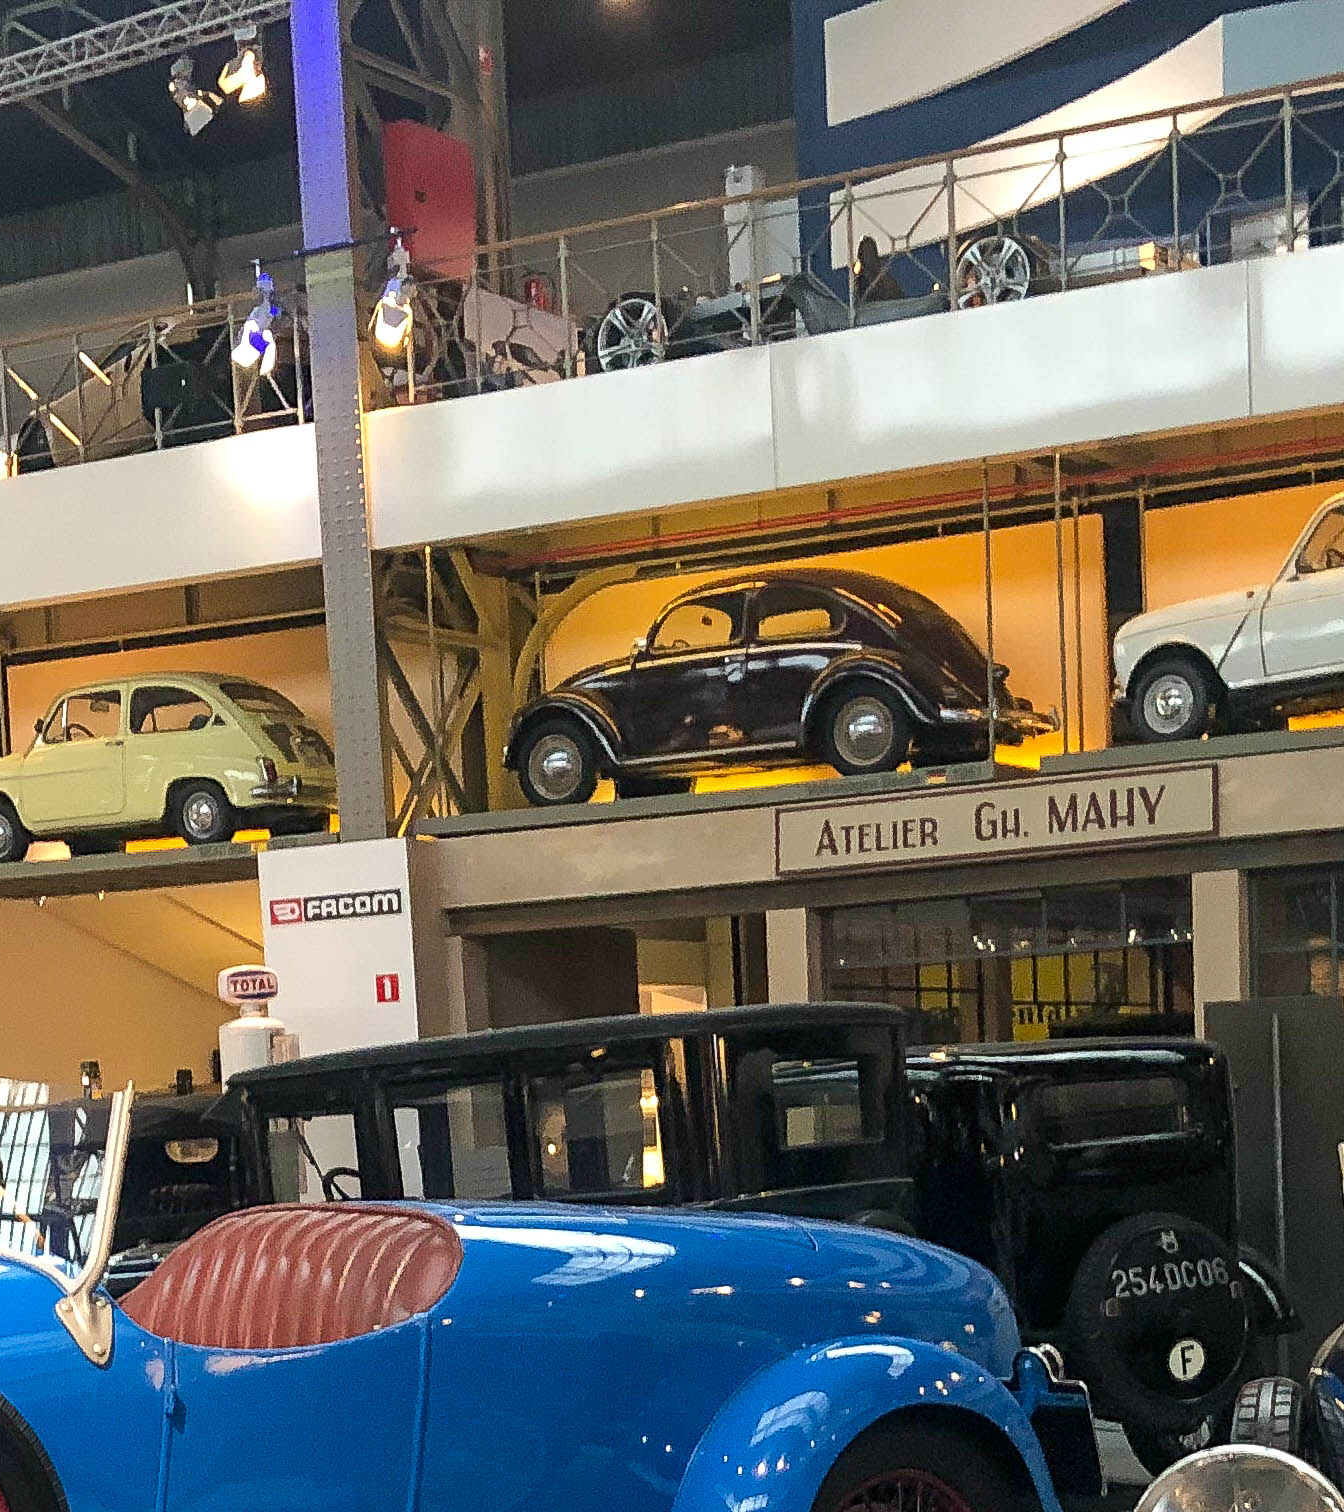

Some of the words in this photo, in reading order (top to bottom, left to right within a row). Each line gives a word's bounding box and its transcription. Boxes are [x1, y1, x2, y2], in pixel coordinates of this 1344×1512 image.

[815, 818, 940, 858] ATELIER
[1047, 784, 1167, 835] MAHY
[306, 892, 399, 919] FACOM
[229, 977, 275, 993] TOTAL
[1111, 1256, 1229, 1298] 254DC06
[1180, 1344, 1195, 1376] F
